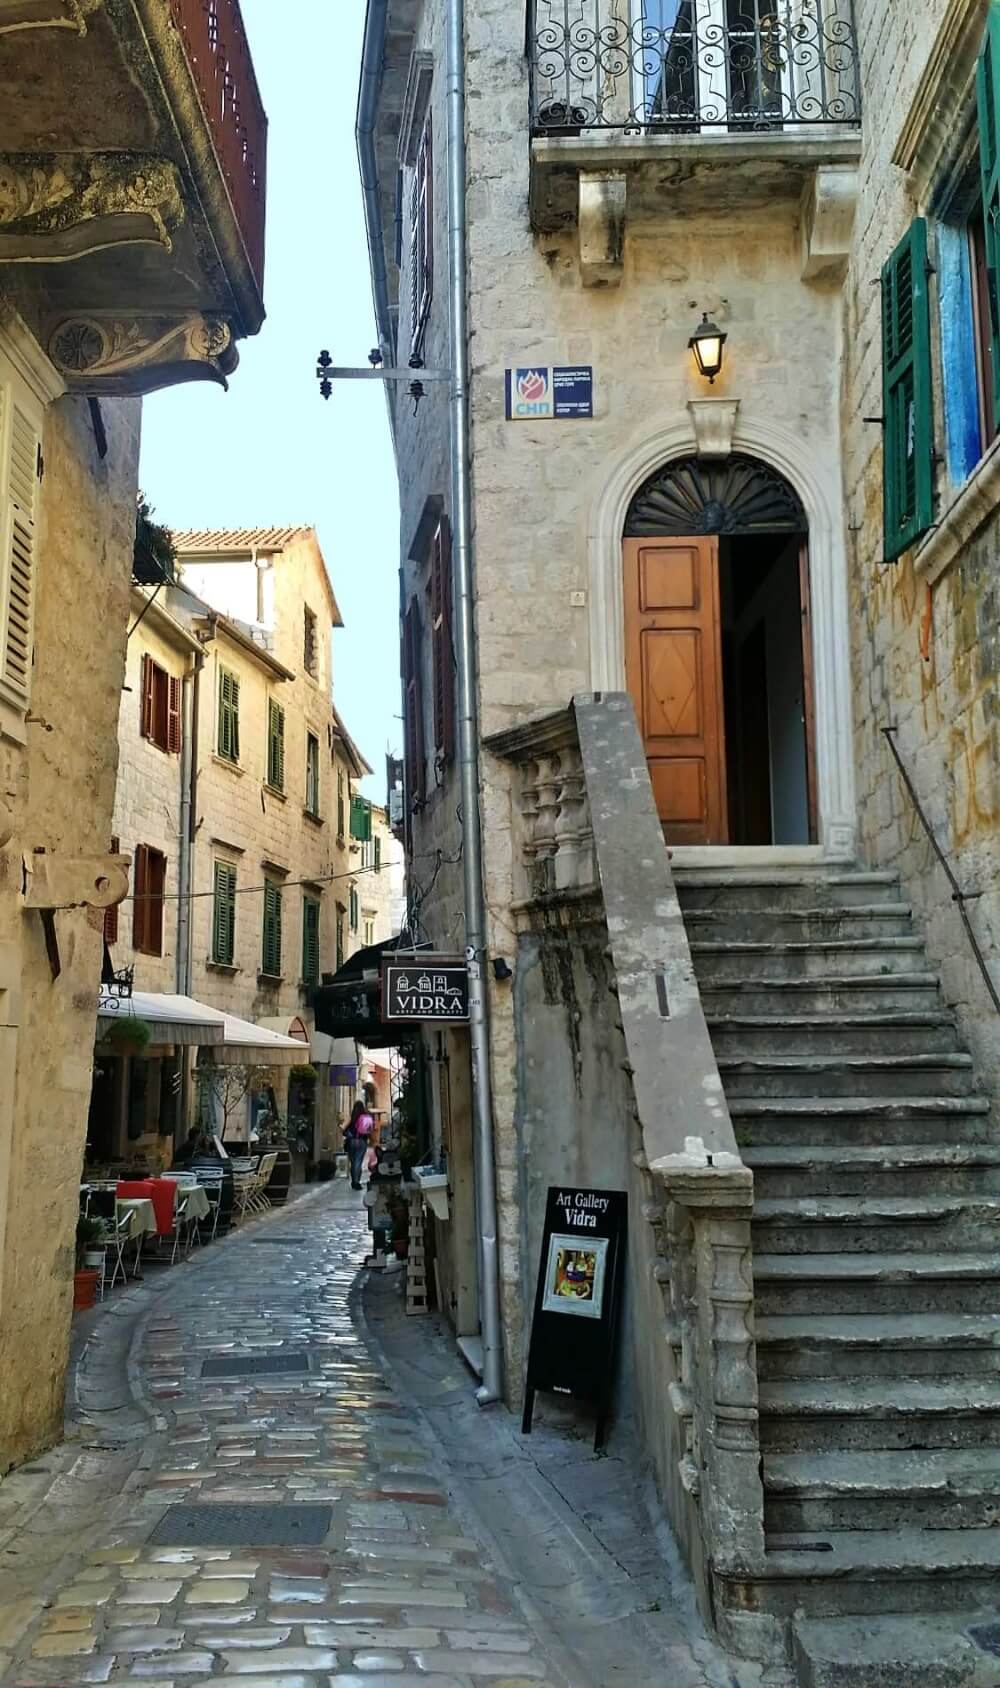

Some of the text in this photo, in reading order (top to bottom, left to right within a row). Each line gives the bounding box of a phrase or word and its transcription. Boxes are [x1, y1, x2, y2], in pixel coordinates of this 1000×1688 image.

[516, 403, 550, 415] СНП
[396, 996, 463, 1010] VIDRA
[555, 1191, 610, 1213] Art Gallery
[565, 1208, 597, 1227] Vidra
